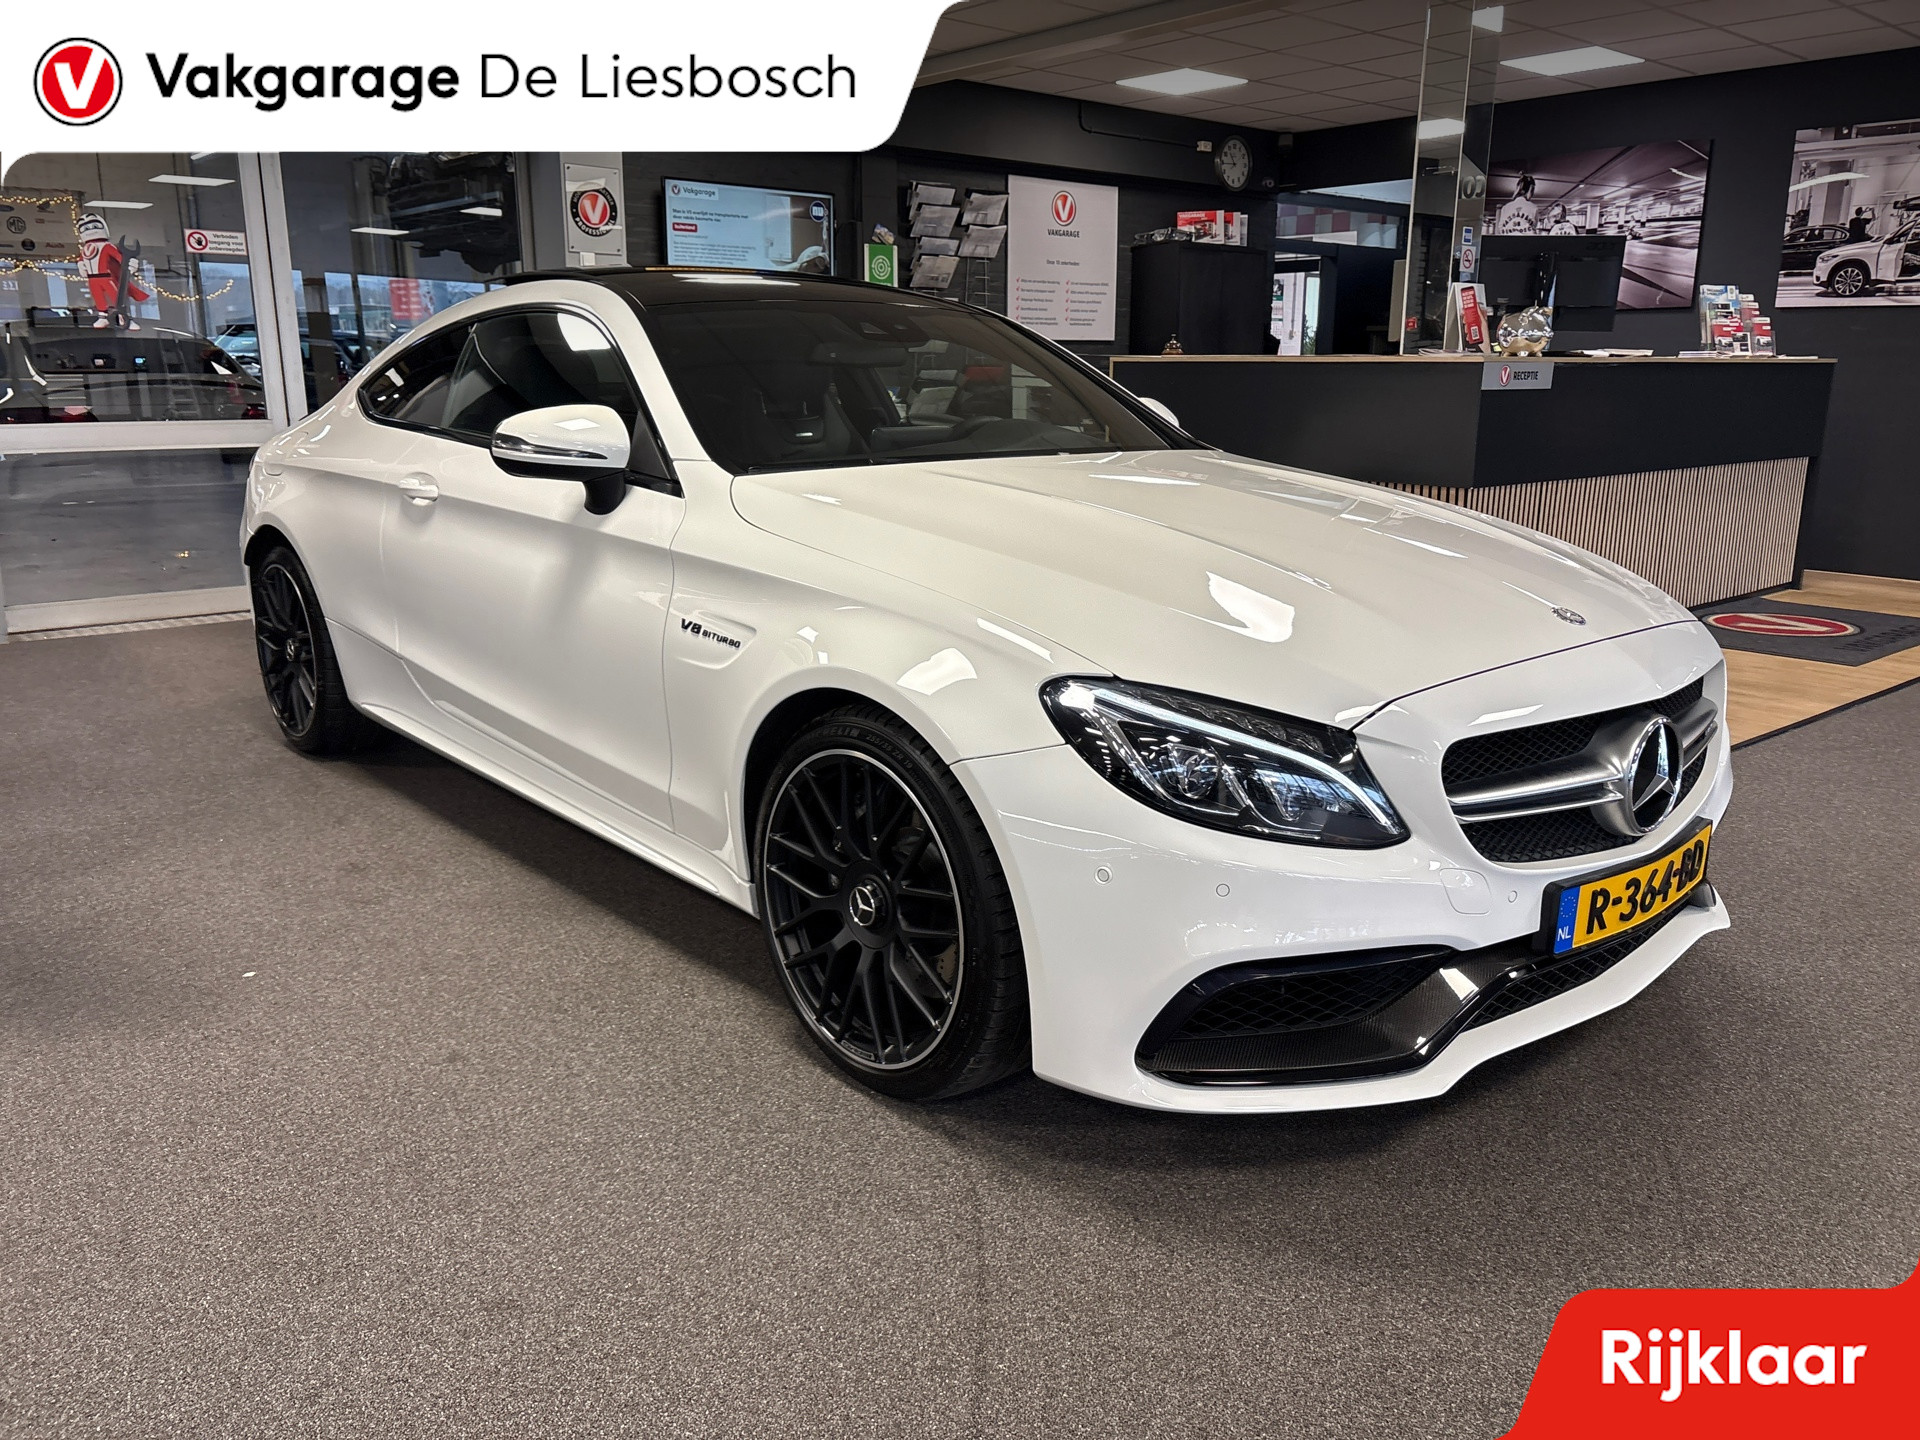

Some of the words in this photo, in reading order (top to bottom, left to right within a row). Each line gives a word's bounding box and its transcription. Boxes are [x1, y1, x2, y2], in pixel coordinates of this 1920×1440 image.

[683, 187, 715, 197] Vakgarage
[575, 217, 615, 235] PROFESSIOAL
[1048, 229, 1080, 238] VAKGARAGE
[1513, 371, 1538, 380] RECEPTIE
[681, 618, 702, 634] V8
[702, 629, 741, 648] BITURBO
[1586, 840, 1704, 934] R-364-BD
[1557, 926, 1571, 941] NL
